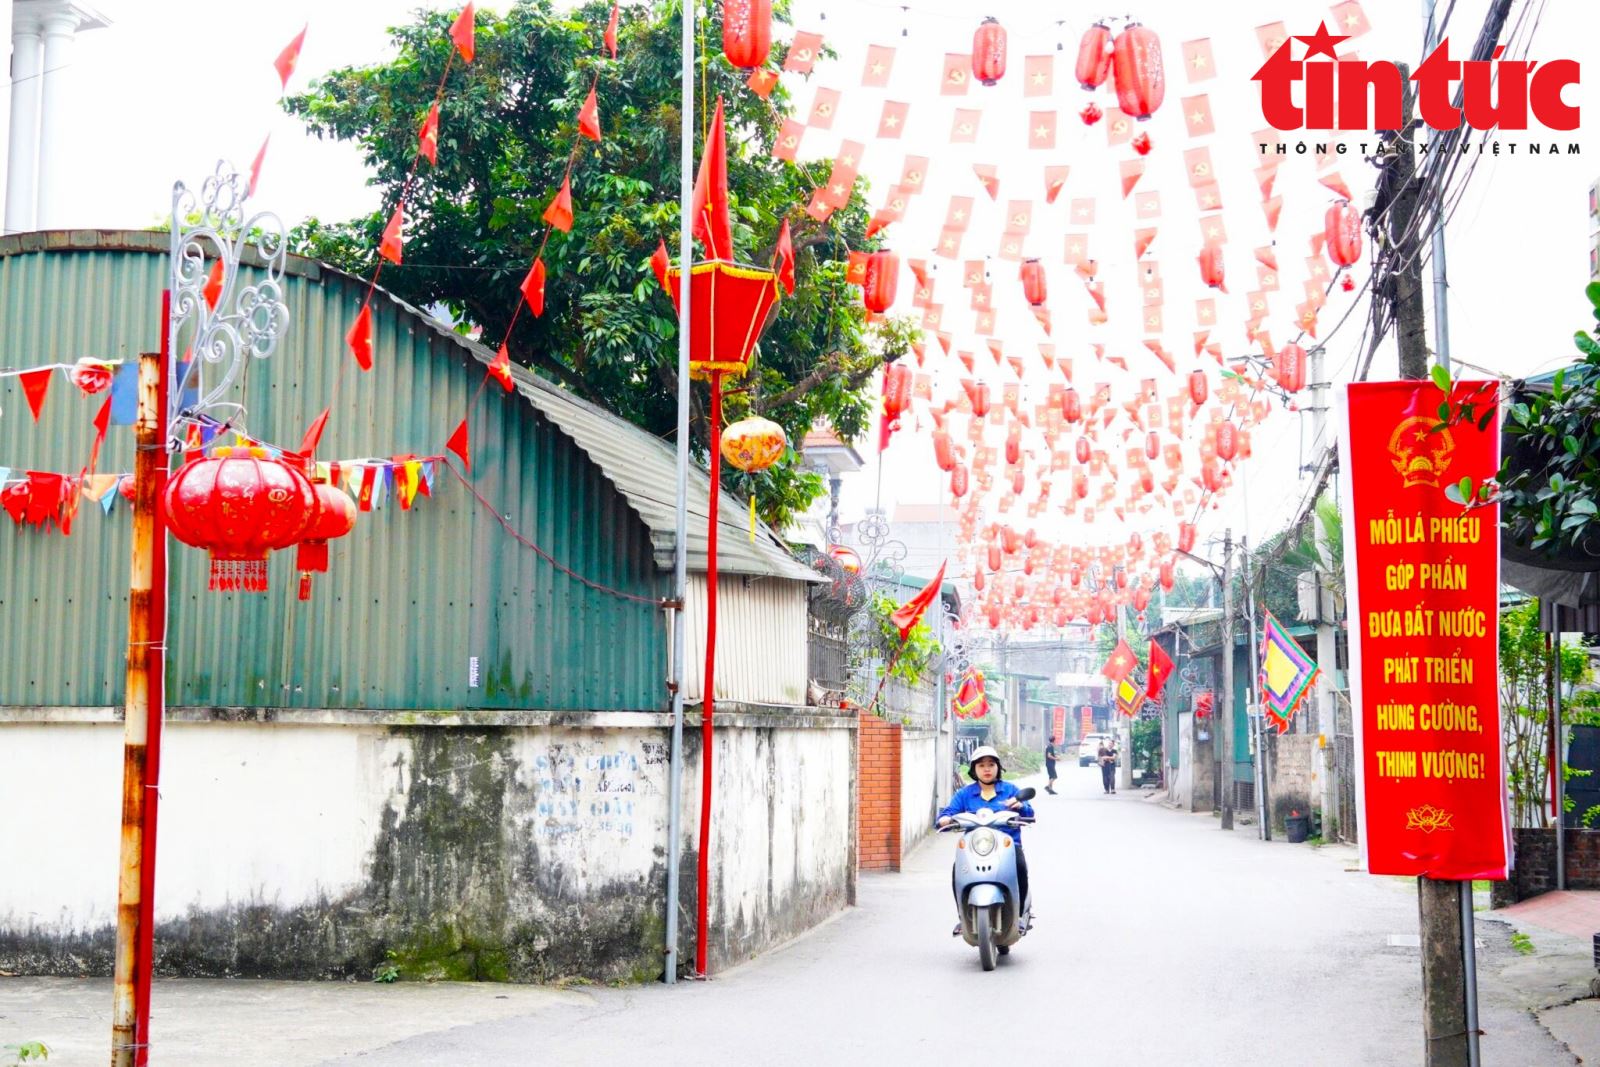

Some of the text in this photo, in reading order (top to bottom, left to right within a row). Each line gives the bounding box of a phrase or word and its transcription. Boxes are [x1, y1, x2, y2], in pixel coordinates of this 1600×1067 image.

[1370, 509, 1401, 544] MỖI
[1406, 512, 1425, 542] LÁ
[1386, 556, 1467, 591] GÓP PHẦN
[1369, 601, 1486, 638] ĐƯA ĐẤT NƯỚC
[1384, 648, 1473, 685] PHÁT TRIỂN
[1377, 699, 1483, 734] HÙNG CƯỜNG,
[1376, 749, 1485, 784] THỊNH VƯỢNG!
